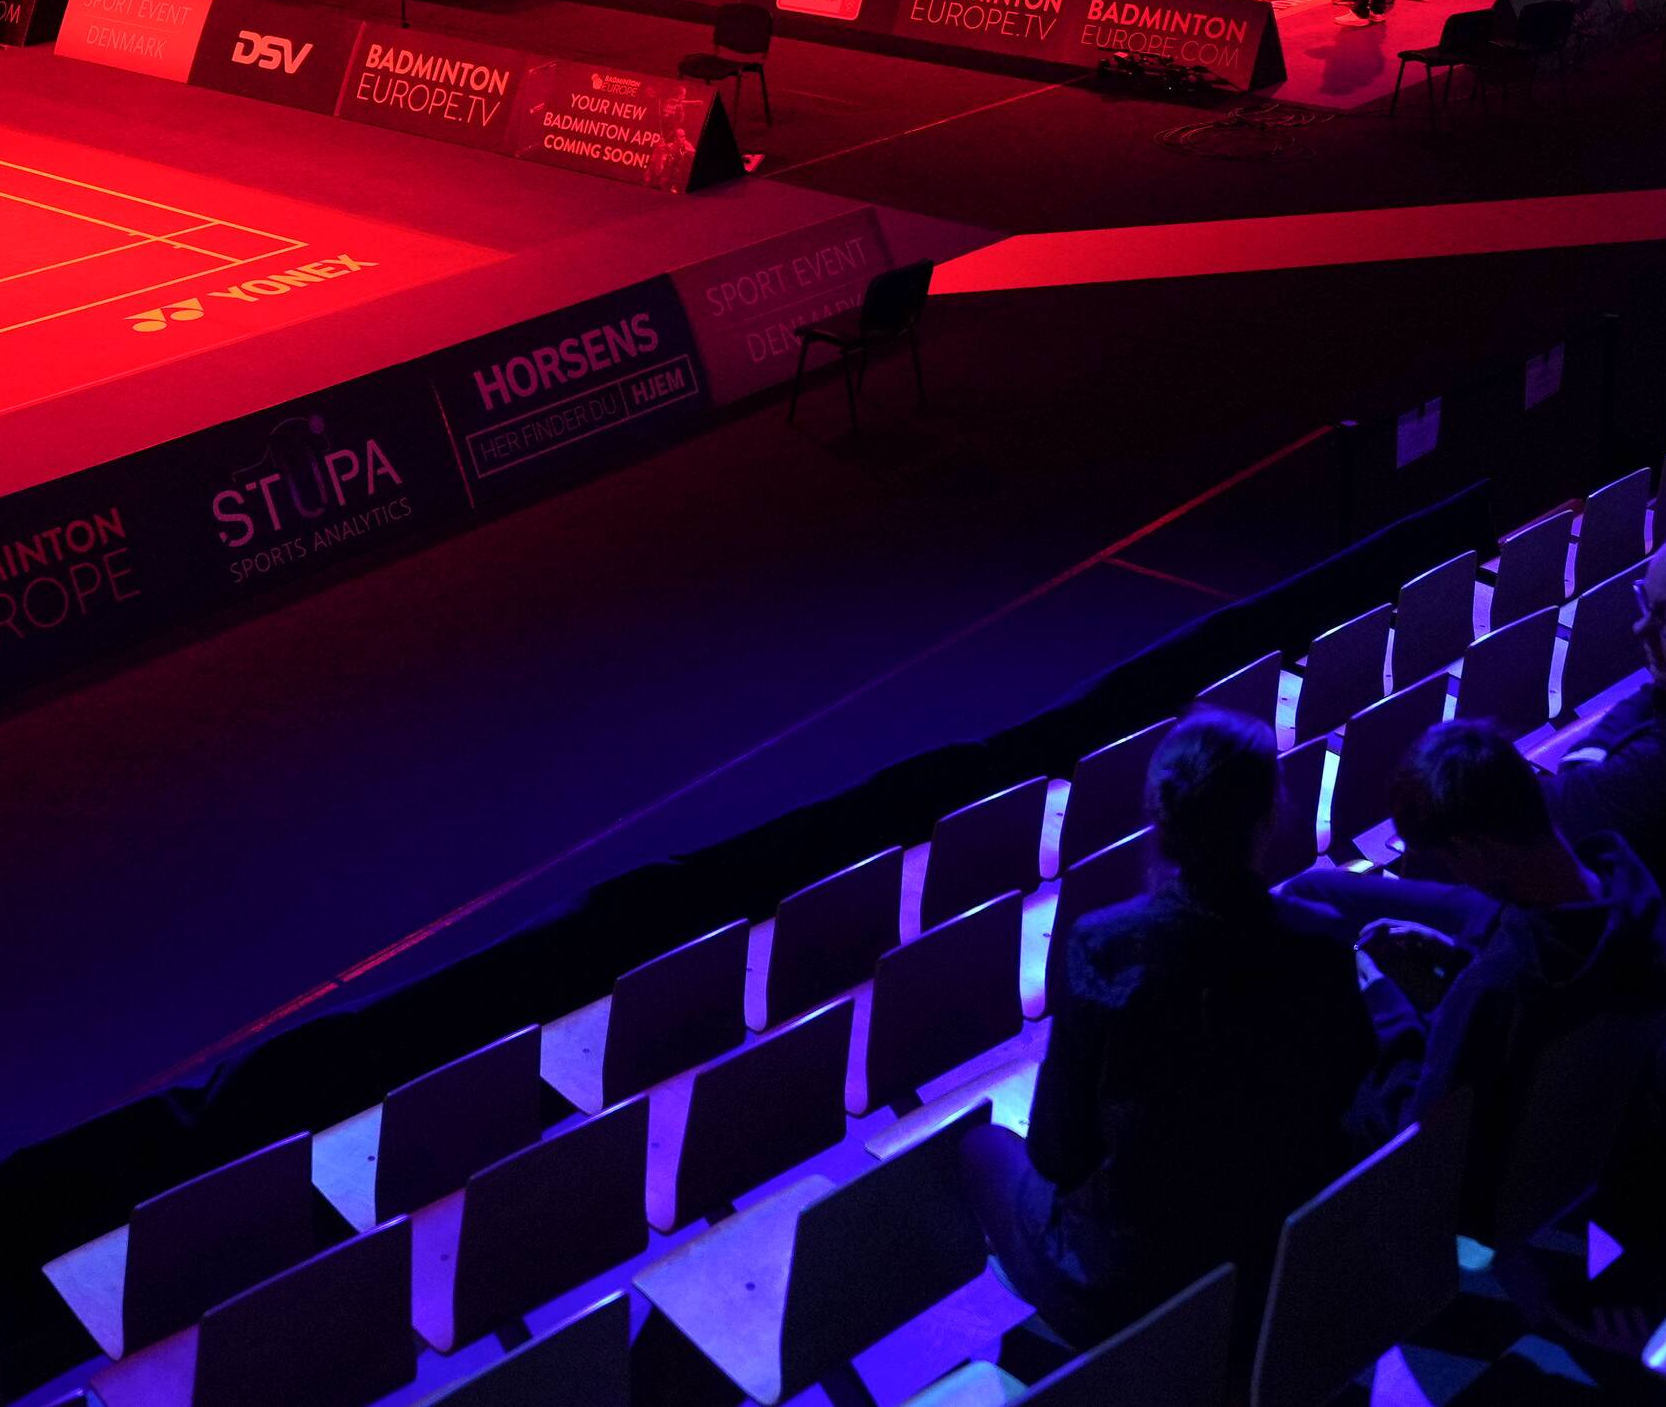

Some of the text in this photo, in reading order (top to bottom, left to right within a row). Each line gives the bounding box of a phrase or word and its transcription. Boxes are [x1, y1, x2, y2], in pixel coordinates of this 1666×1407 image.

[86, 25, 168, 59] DENMARK
[230, 29, 315, 75] DSV
[365, 43, 510, 97] BADMINTON
[601, 82, 639, 97] EUROPE
[355, 71, 502, 128] EUROPE.TV
[570, 93, 647, 122] YOUR NEW
[542, 111, 661, 148] BADMINTON APP
[543, 134, 651, 170] COMING SOON!
[207, 253, 380, 303] YONEX
[705, 235, 870, 318] SPORT EVENT
[472, 311, 661, 412] HORSENS
[479, 366, 685, 464] HER FINDER DU HJEM
[211, 435, 405, 551] STUPA
[228, 496, 414, 584] SPORTS ANALYTICS
